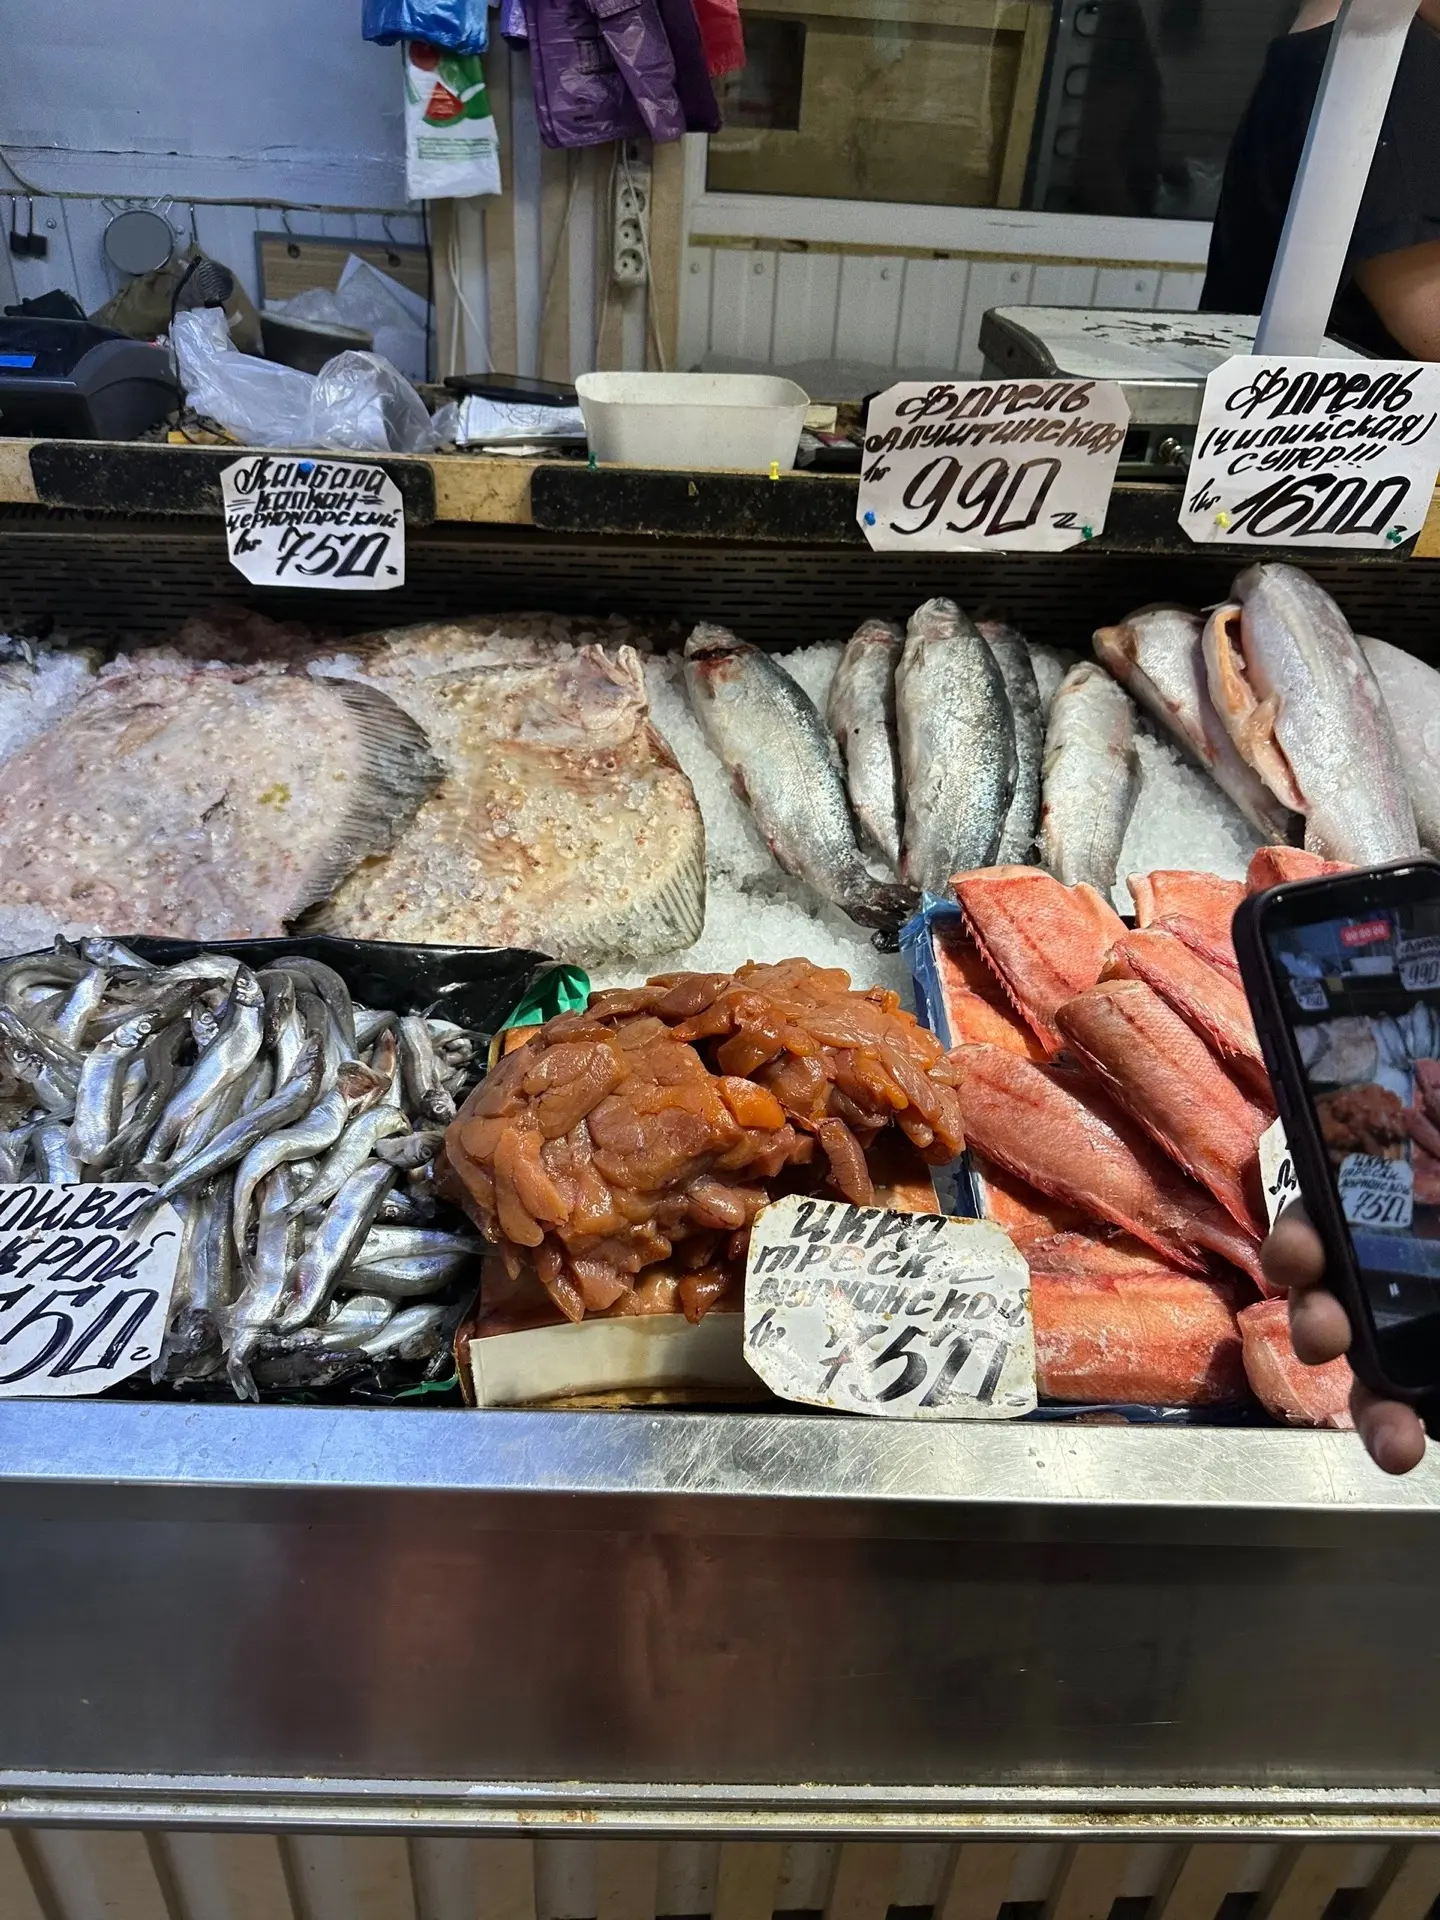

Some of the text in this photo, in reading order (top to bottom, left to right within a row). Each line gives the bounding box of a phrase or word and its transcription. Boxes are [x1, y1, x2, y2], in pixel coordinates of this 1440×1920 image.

[890, 455, 1062, 537] 990
[1227, 473, 1411, 538] 1600
[275, 526, 391, 578] 750
